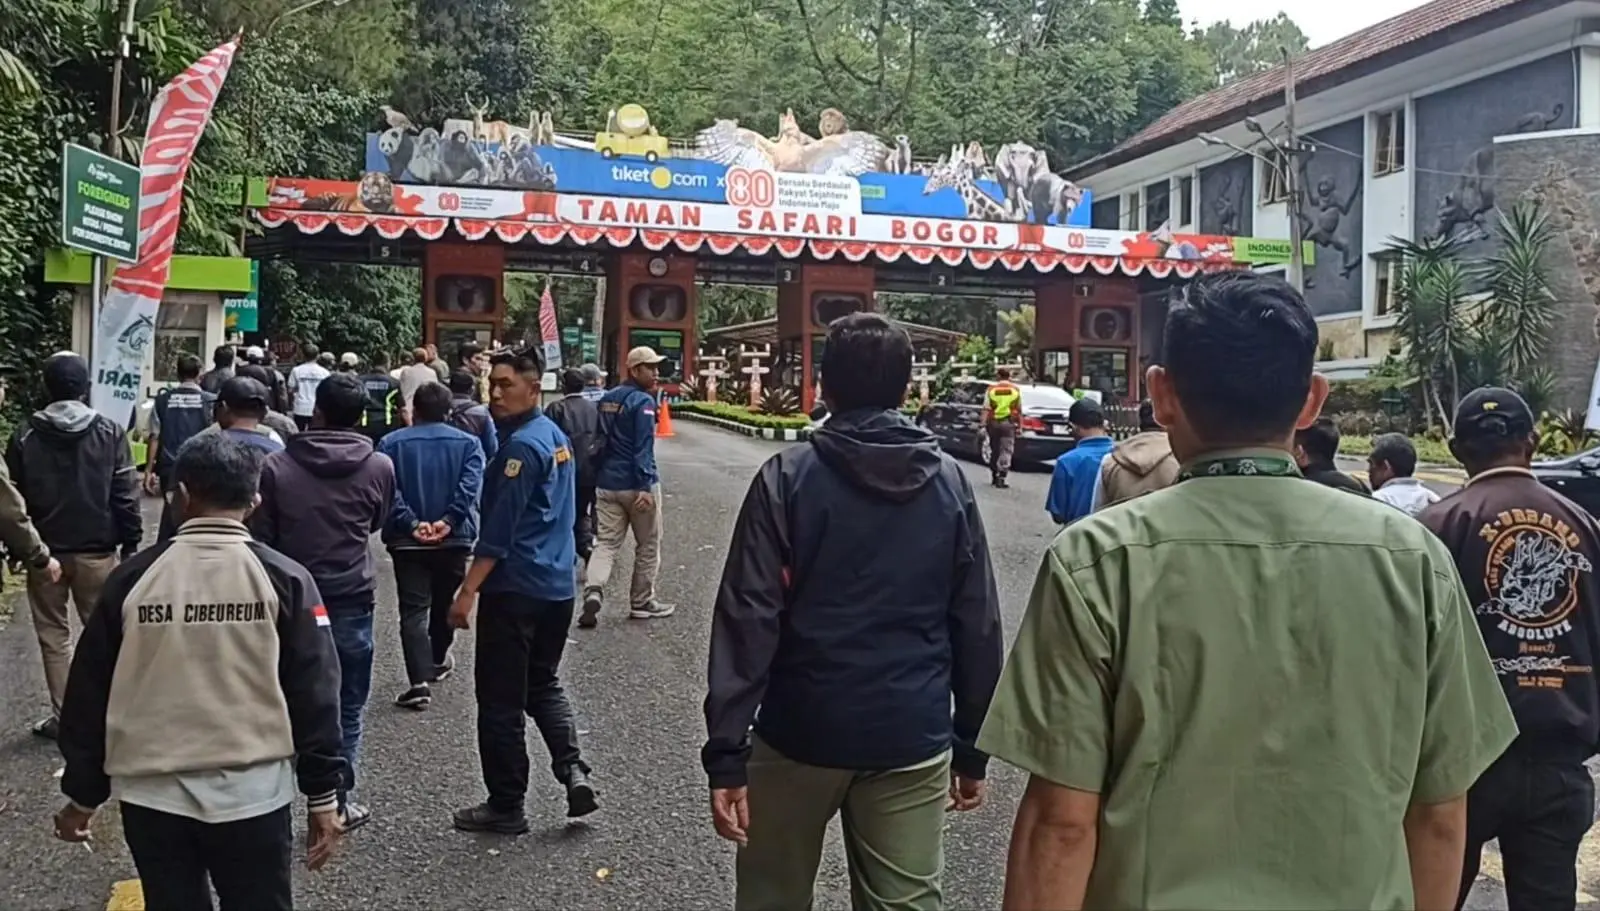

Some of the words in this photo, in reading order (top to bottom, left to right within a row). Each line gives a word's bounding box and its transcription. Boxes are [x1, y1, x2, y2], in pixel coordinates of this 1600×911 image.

[78, 180, 131, 210] FOREIGNERS
[727, 167, 775, 208] 80
[778, 188, 807, 198] Rakyat
[779, 199, 819, 208] Indonesia
[577, 198, 701, 227] TAMAN
[737, 209, 857, 237] SAFARI
[891, 219, 999, 246] BOGOR
[381, 246, 390, 257] 5
[1248, 243, 1291, 253] INDONES
[137, 604, 173, 624] DESA
[184, 601, 266, 624] CIBEUREUM
[1497, 619, 1573, 640] ABSOLUTE
